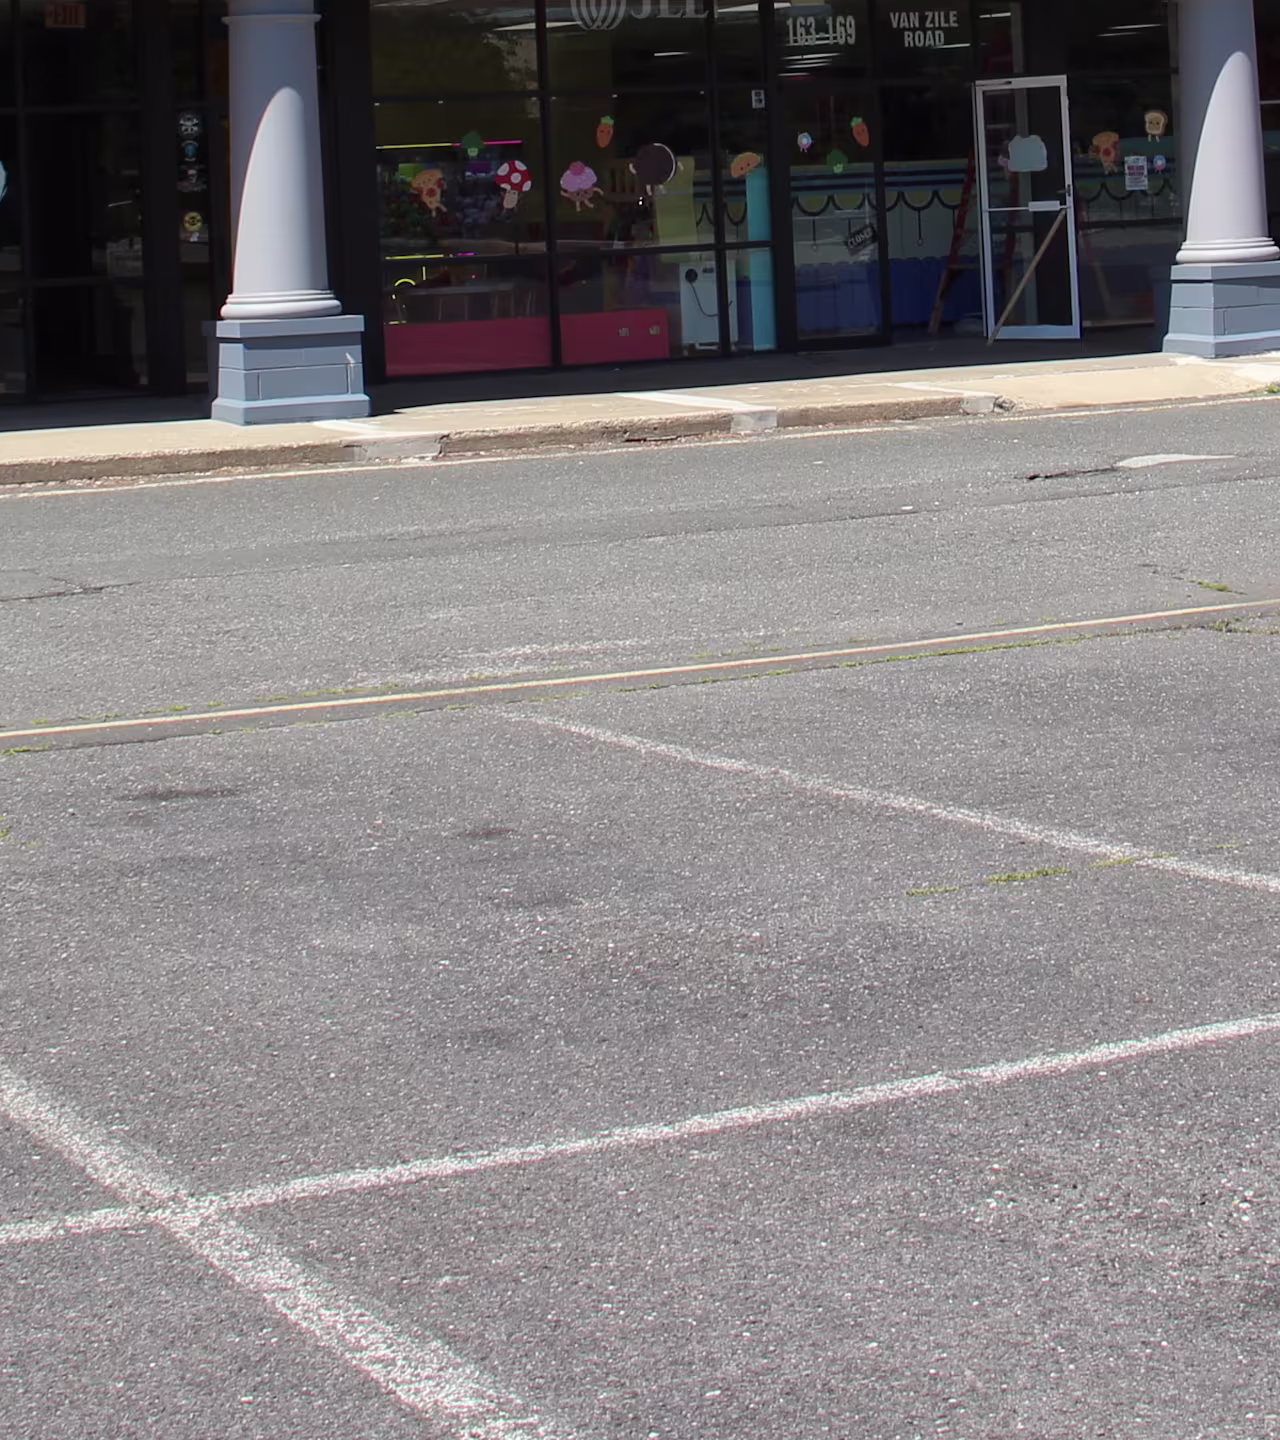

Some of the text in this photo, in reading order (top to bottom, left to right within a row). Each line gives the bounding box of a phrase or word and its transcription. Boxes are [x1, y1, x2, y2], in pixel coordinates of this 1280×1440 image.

[890, 11, 959, 28] VAN ZILE
[786, 15, 856, 45] 163-169
[904, 30, 945, 47] ROAD
